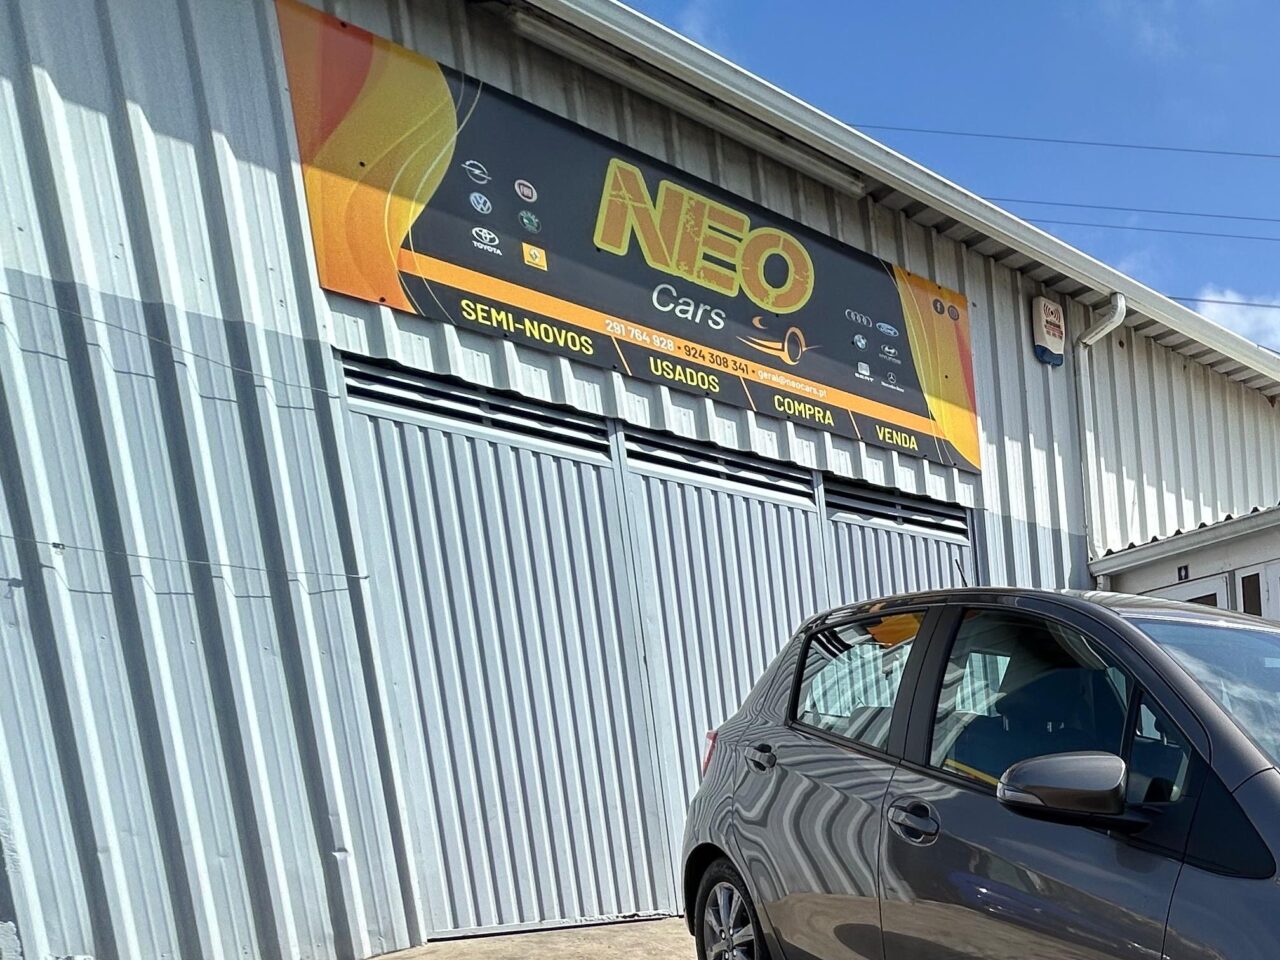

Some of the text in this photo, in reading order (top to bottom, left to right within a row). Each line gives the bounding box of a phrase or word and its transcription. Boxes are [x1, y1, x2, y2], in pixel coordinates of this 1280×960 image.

[471, 240, 502, 256] TOYOTA
[593, 157, 814, 314] NEO
[460, 299, 594, 355] SEMI-NOVOS
[652, 283, 726, 330] Cars
[605, 319, 626, 336] 291
[627, 325, 650, 345] 764
[652, 334, 675, 352] 928
[683, 344, 706, 362] 924
[708, 351, 729, 369] 308
[731, 358, 749, 375] 341
[649, 356, 720, 393] USADOS
[774, 394, 835, 427] COMPRA
[875, 424, 919, 451] VENDA
